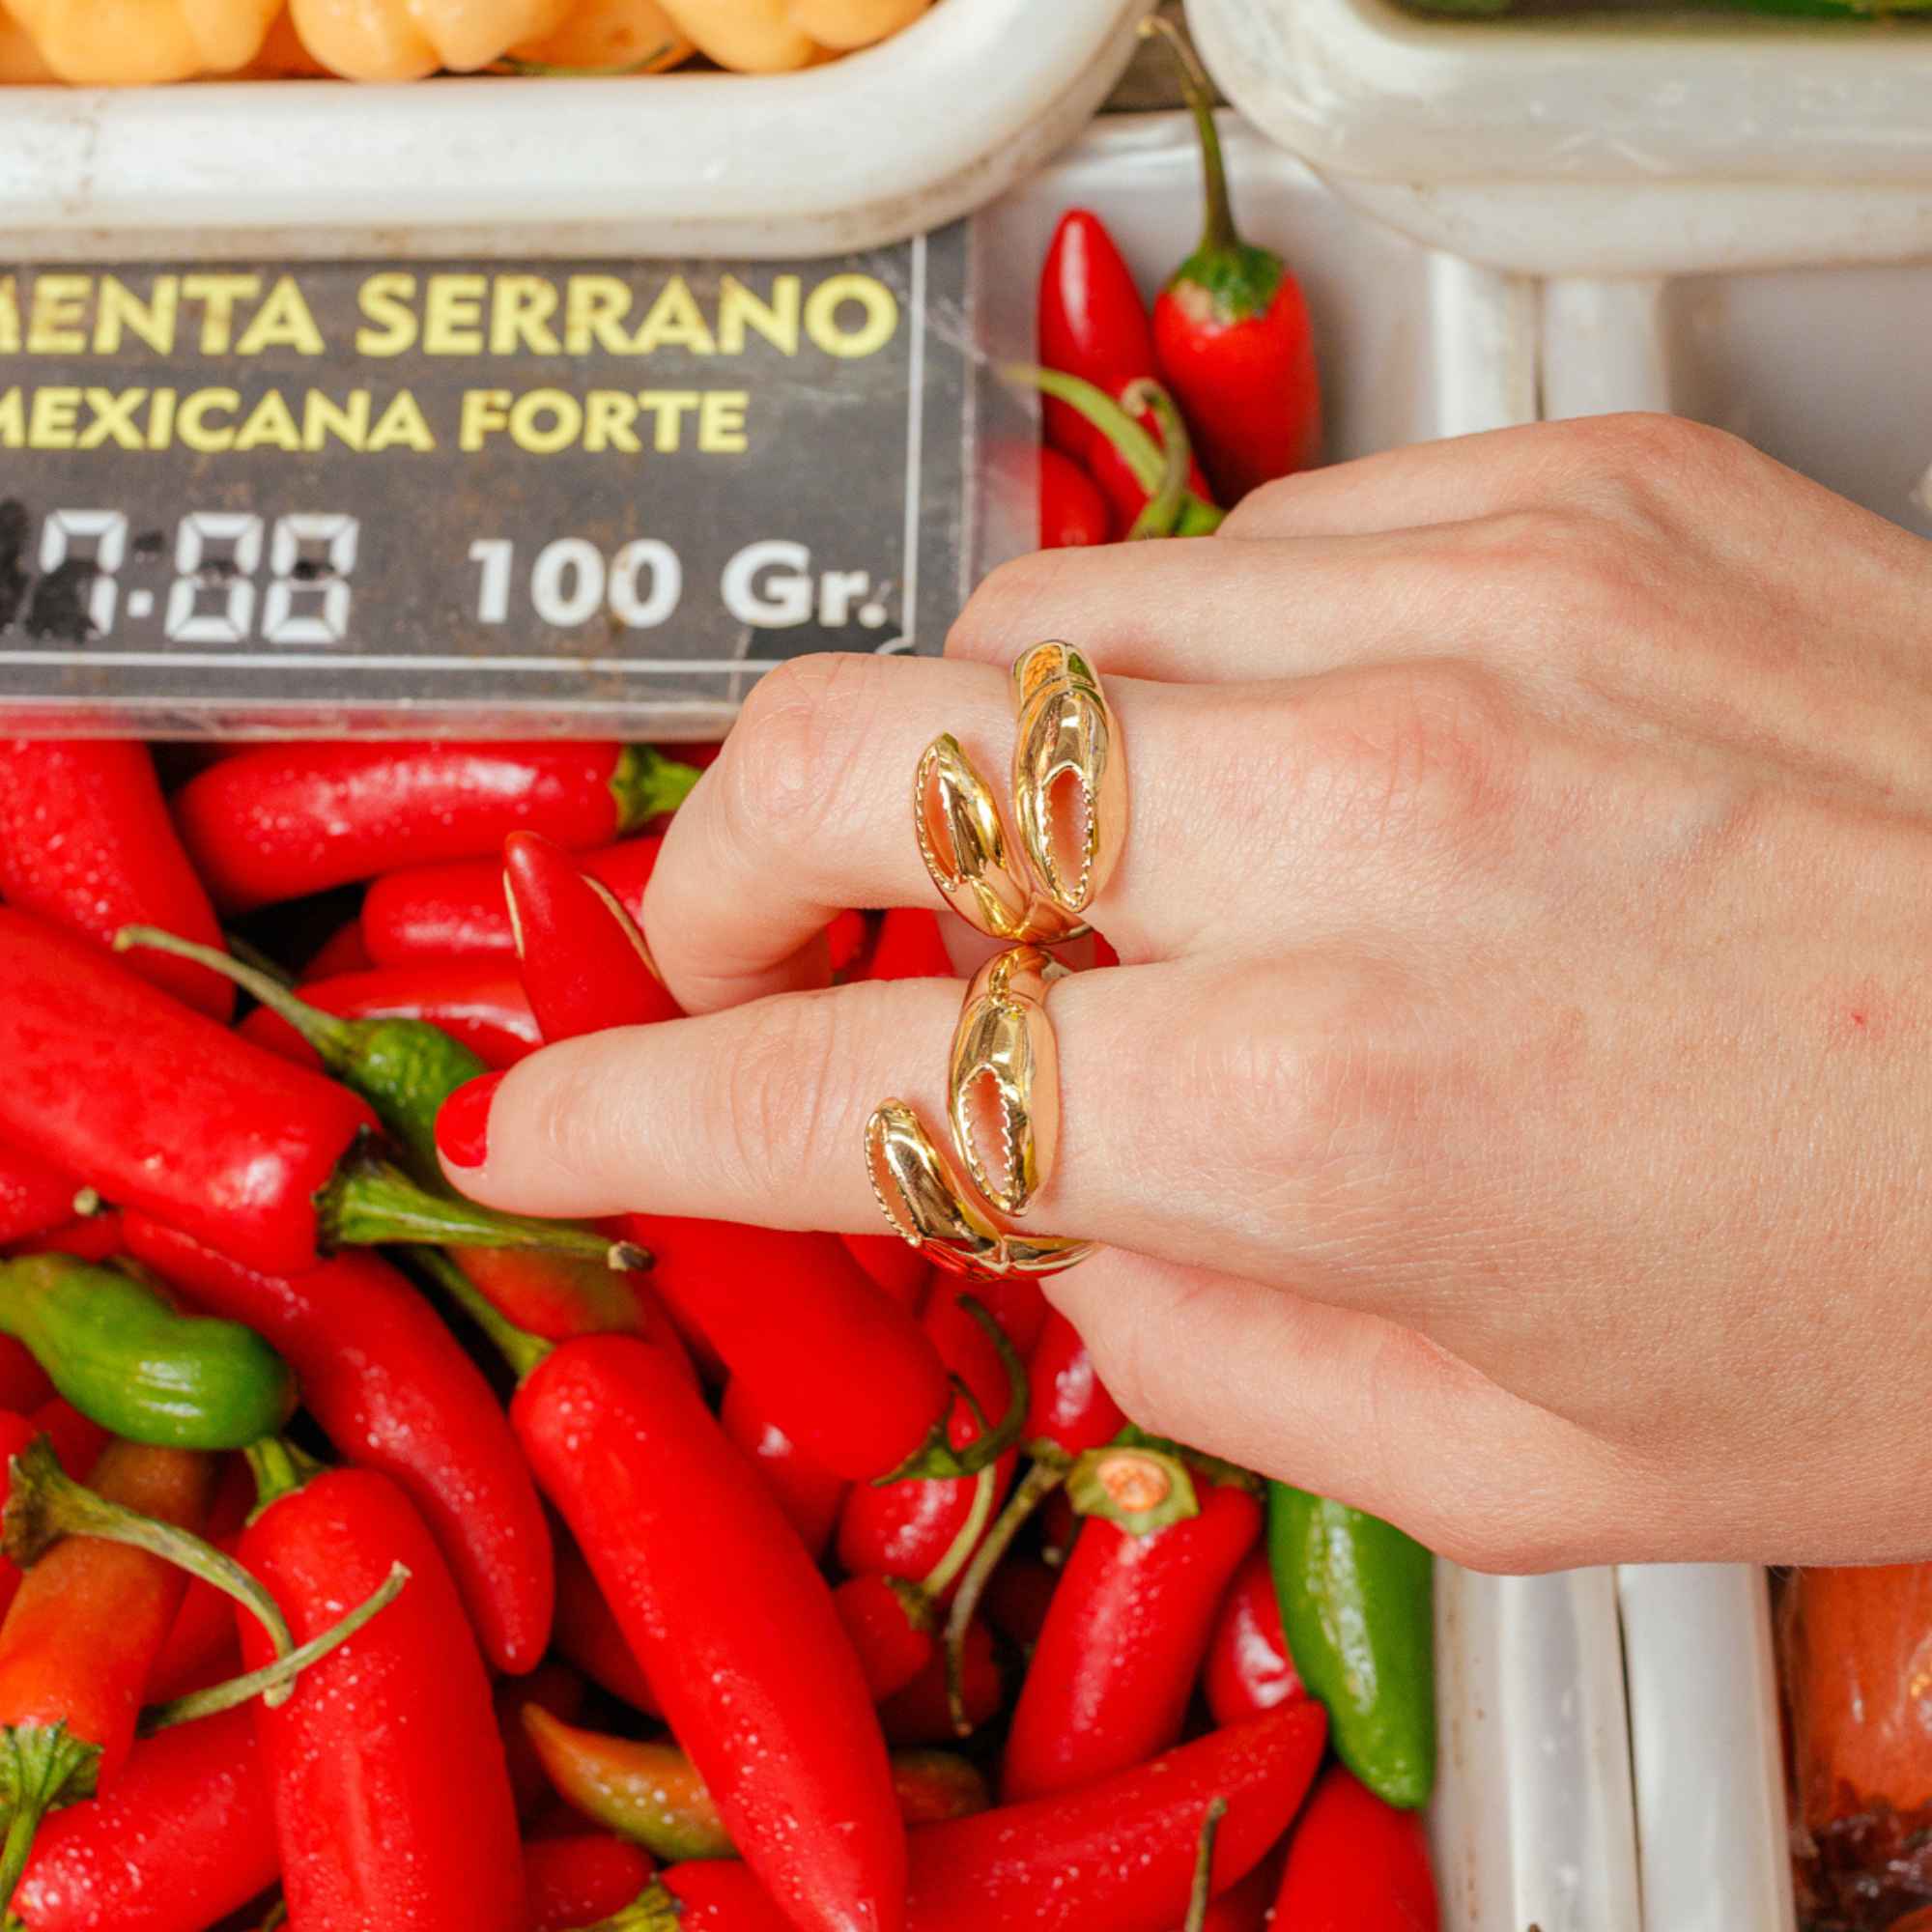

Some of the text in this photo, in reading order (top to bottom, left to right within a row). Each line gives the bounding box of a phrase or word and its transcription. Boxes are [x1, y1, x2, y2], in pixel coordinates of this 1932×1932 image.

[0, 272, 898, 357] ENTA SERRANO
[459, 387, 749, 454] FORTE
[468, 537, 682, 628] 100
[721, 539, 888, 629] Gr.
